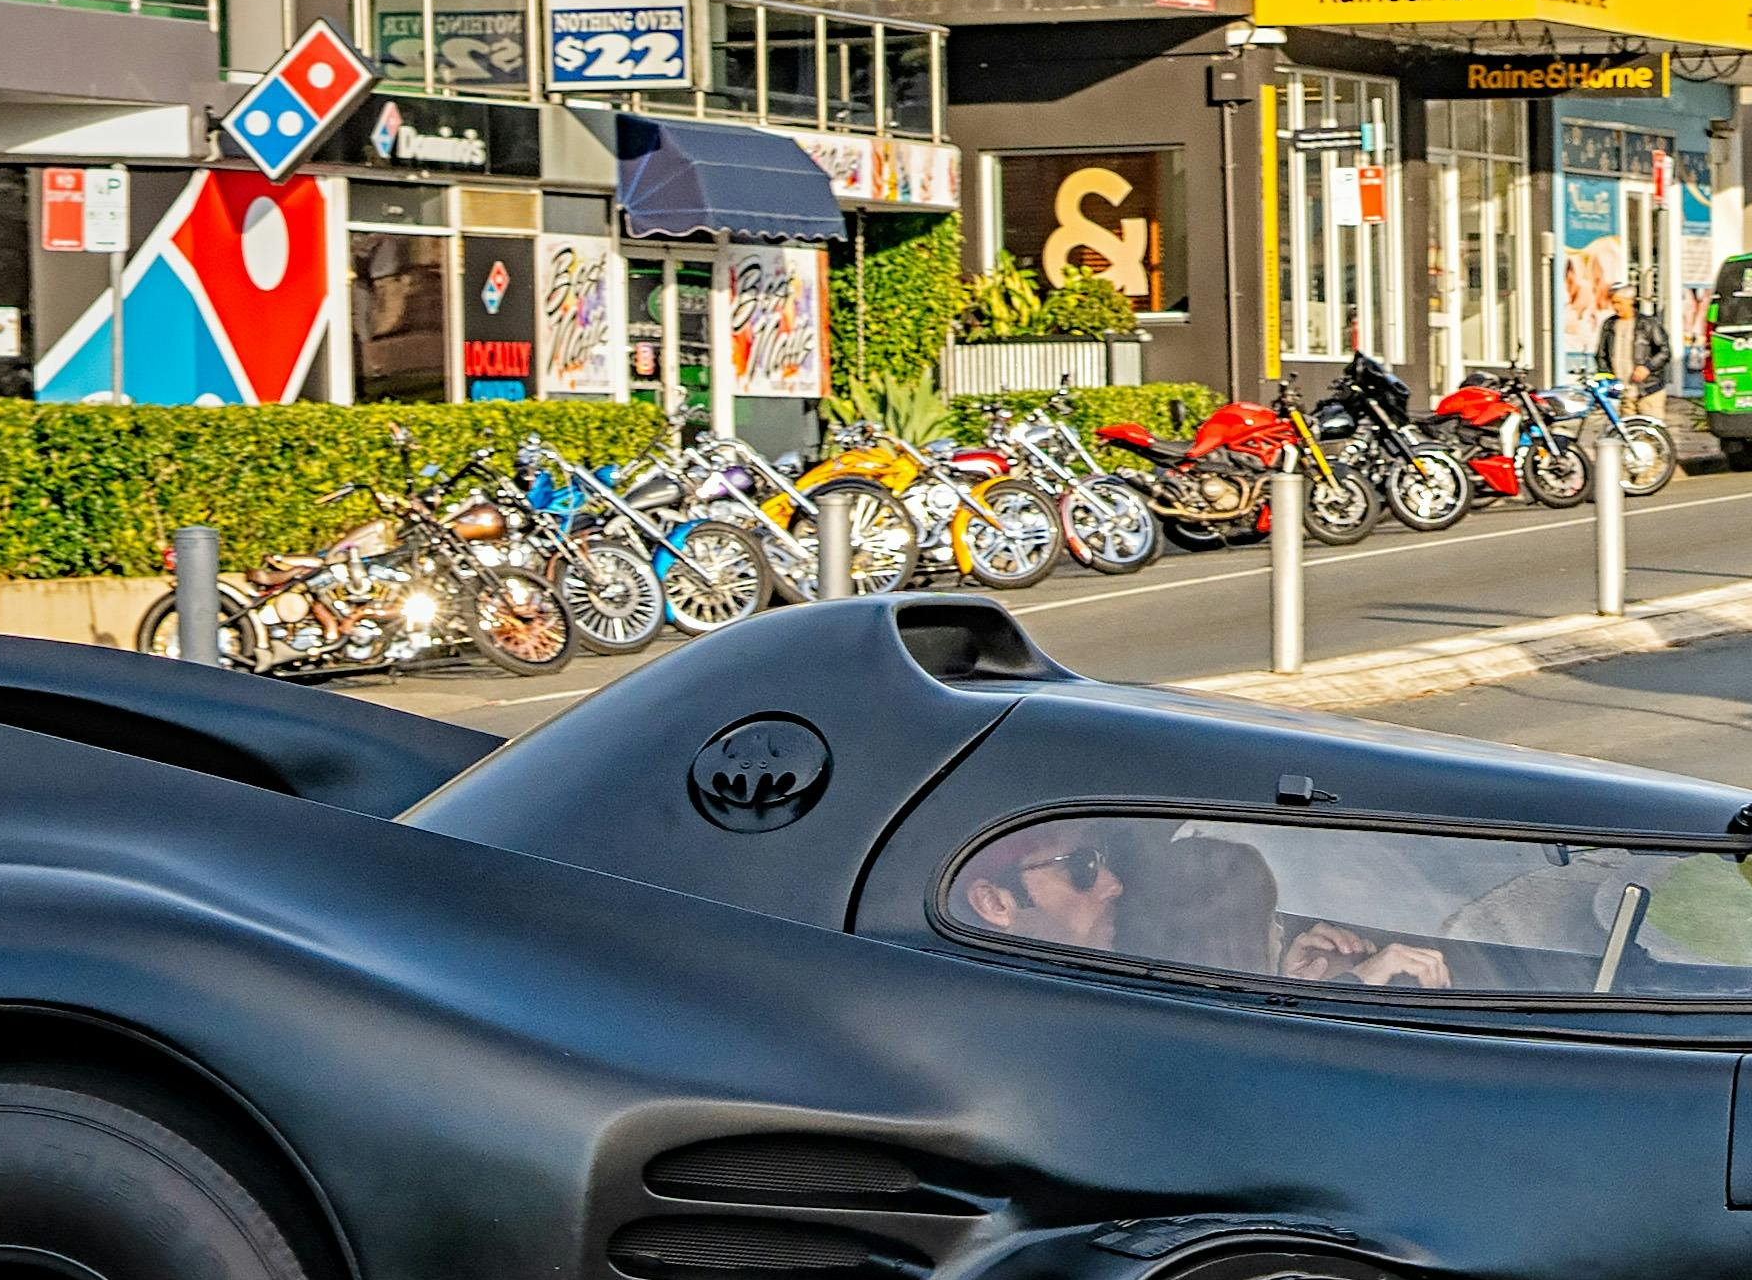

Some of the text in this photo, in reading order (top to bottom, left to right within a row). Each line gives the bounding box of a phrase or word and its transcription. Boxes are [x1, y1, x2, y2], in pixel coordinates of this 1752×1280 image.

[554, 9, 684, 34] NOTHING OVER
[554, 31, 683, 80] $22
[1467, 62, 1654, 90] Raine&Horne
[398, 125, 487, 165] Domino's
[464, 340, 533, 378] LOCALLY
